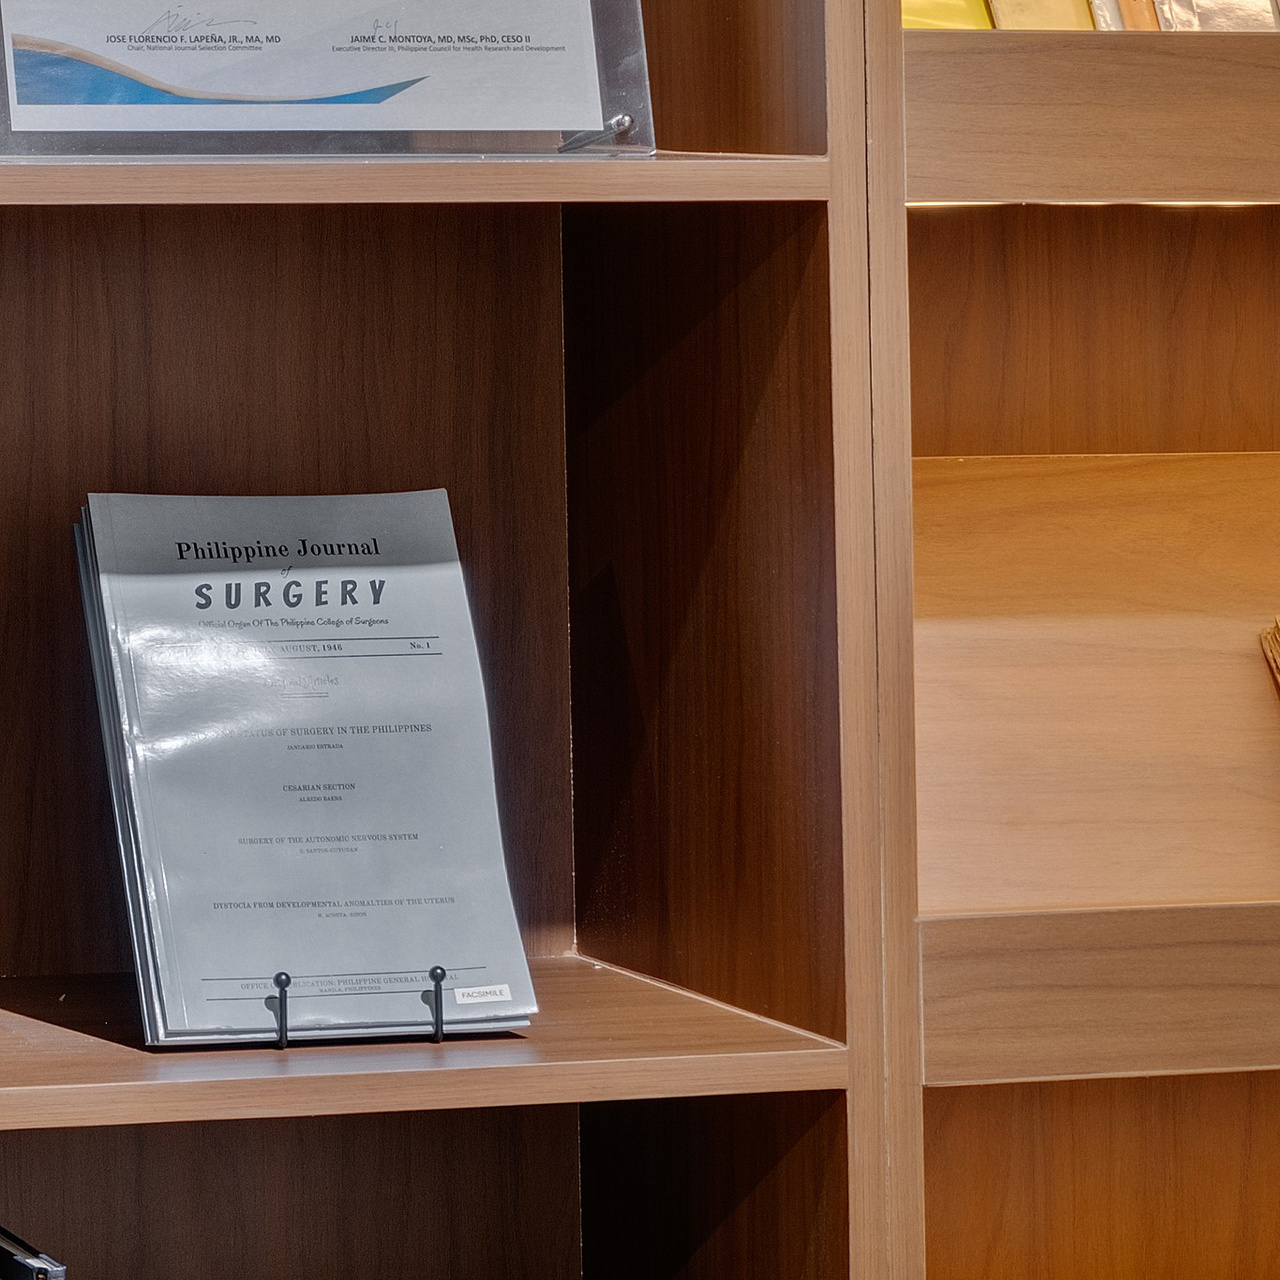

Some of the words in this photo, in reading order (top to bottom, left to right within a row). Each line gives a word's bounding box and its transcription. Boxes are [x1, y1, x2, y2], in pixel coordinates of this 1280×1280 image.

[106, 35, 126, 43] JOSE
[128, 35, 178, 43] FLORENCIO
[180, 35, 187, 43] F.
[189, 33, 226, 45] LAPEÑA,
[228, 35, 243, 45] JR.,
[245, 35, 263, 45] MA,
[265, 35, 281, 43] MD
[175, 541, 290, 563] Philippine
[297, 538, 380, 557] Journal
[280, 566, 293, 578] of
[195, 579, 386, 610] SURGERY
[290, 727, 334, 736] SURGERY
[337, 726, 348, 734] IN
[350, 726, 370, 734] THE
[372, 724, 432, 734] PHILIPPINES
[282, 784, 321, 792] CESARIAN
[323, 783, 356, 791] SECTION
[461, 989, 504, 999] FACSIMILE
